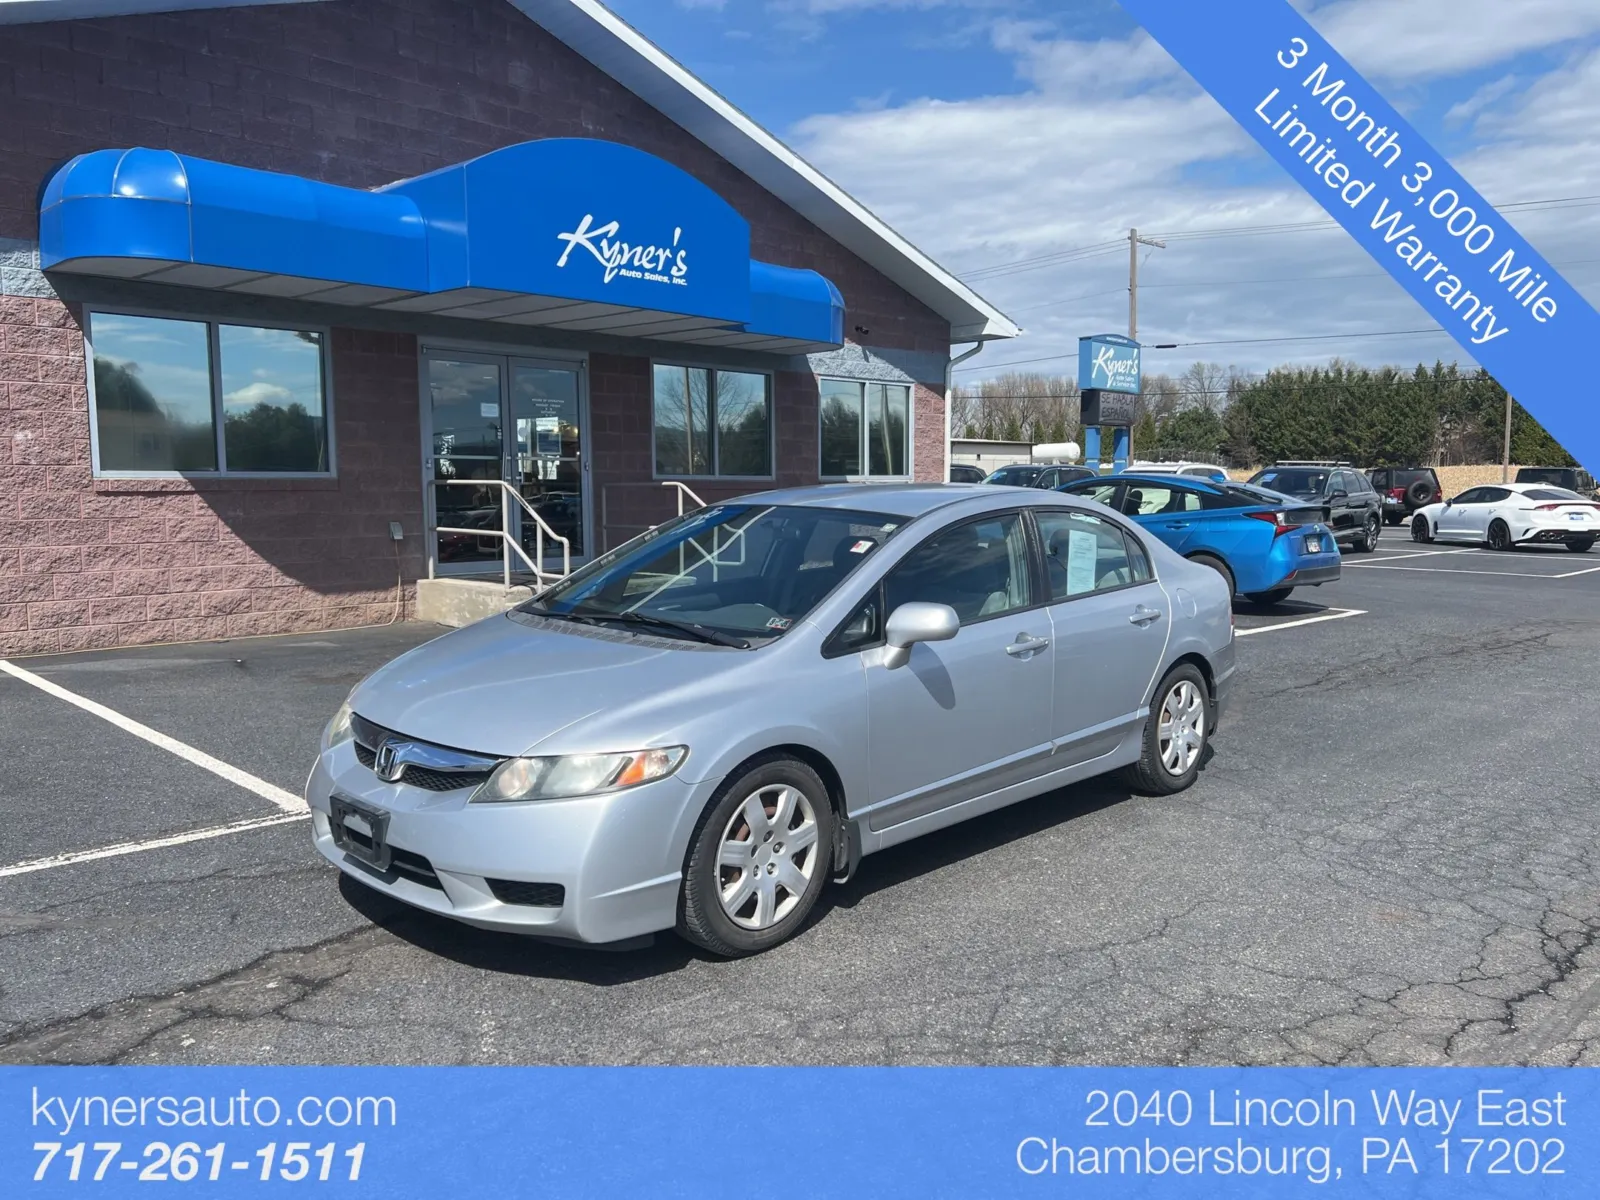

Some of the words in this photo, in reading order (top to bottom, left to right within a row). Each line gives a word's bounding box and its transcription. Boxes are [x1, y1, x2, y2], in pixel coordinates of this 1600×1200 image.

[556, 213, 688, 284] Kyner's
[619, 268, 642, 279] Auto
[644, 272, 670, 284] Sales,
[1092, 346, 1138, 388] Kyner's
